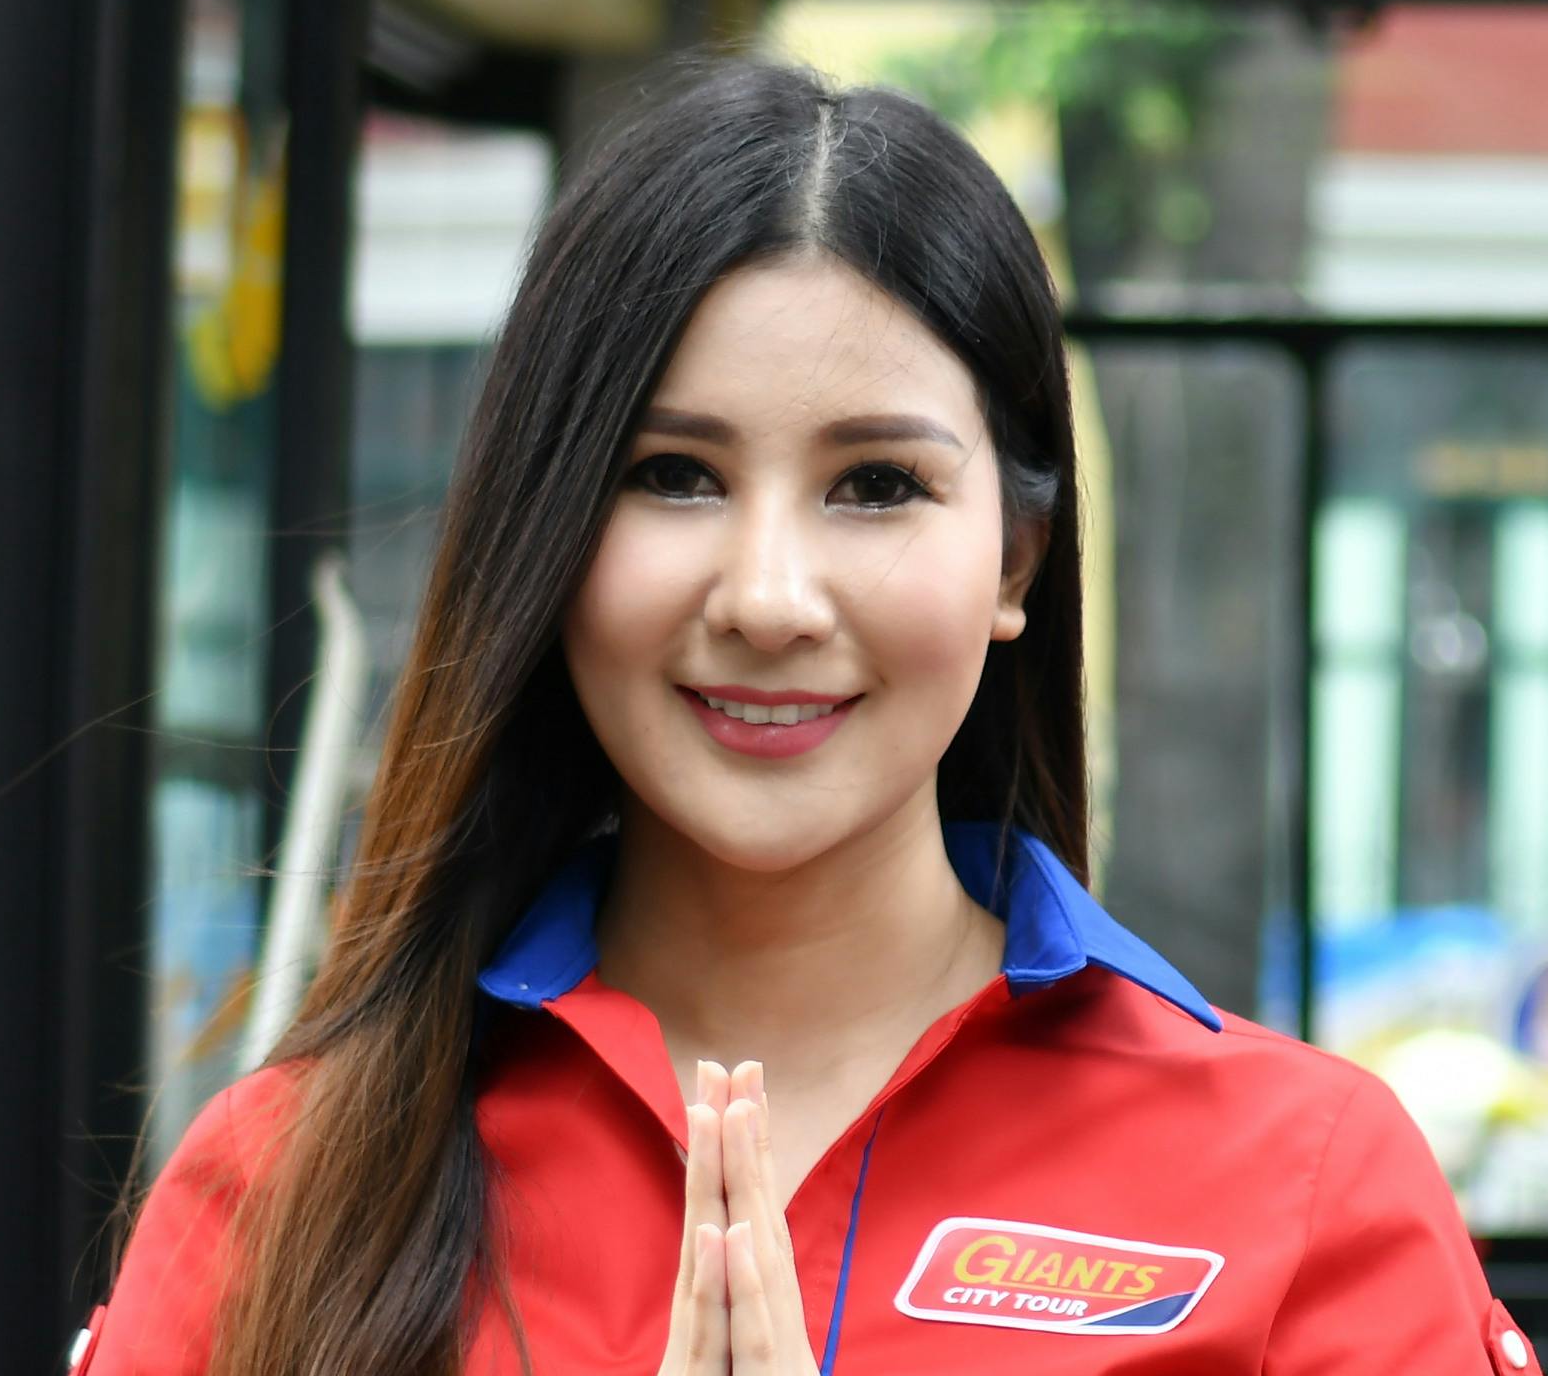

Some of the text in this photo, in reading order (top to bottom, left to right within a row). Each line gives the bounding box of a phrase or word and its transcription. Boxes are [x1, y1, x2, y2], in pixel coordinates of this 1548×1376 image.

[953, 1234, 1164, 1296] GIANTS
[942, 1286, 1089, 1317] CITY TOUR
